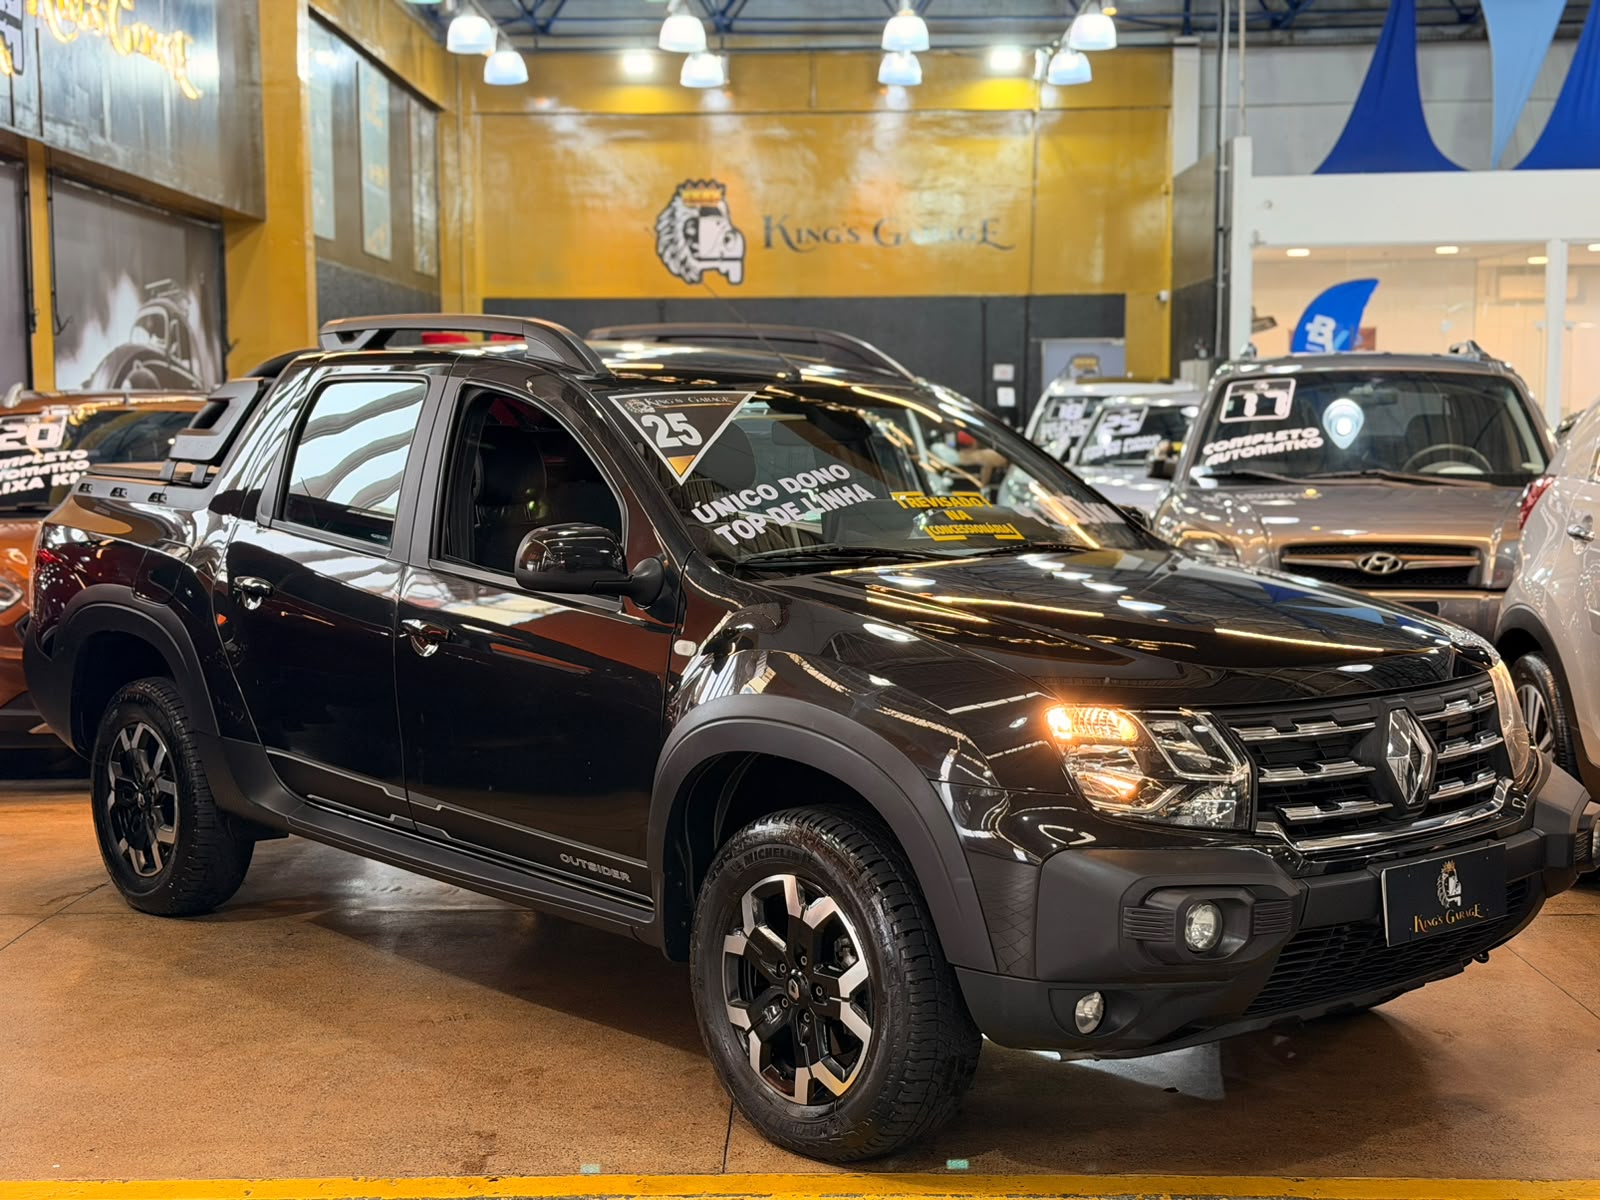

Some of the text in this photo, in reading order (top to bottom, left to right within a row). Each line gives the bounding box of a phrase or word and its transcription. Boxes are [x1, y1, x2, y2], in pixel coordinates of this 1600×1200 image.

[640, 412, 704, 449] 25
[1202, 427, 1320, 455] COMPLETO
[0, 476, 45, 496] IXA
[691, 464, 851, 524] ÚNICO DONO
[713, 483, 877, 546] TOP DE LINHA
[905, 496, 985, 508] REVISADO
[943, 509, 974, 521] NA
[559, 853, 632, 883] OUTSIDER
[1414, 903, 1485, 933] KING'S GARAGE
